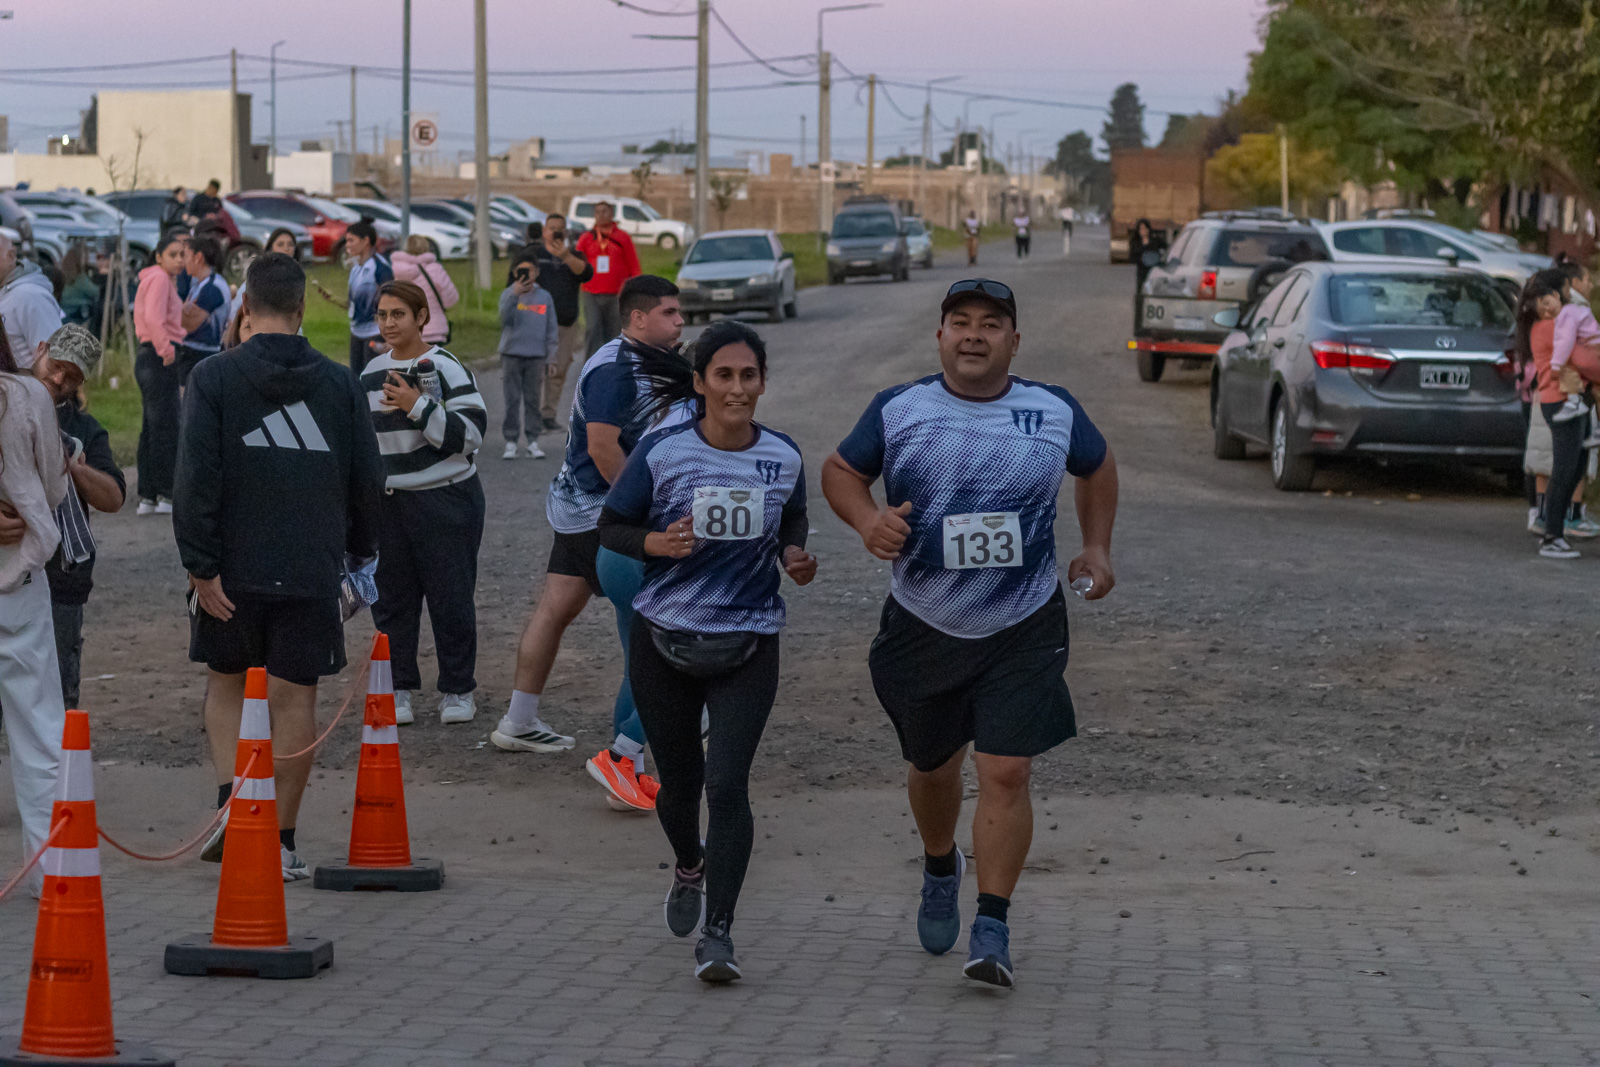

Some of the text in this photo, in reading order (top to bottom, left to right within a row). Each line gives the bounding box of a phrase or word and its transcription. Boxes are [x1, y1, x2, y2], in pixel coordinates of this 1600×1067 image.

[419, 126, 431, 140] E
[1147, 305, 1165, 319] 80
[760, 461, 777, 470] SFC
[706, 505, 751, 537] 80
[951, 531, 1014, 565] 133
